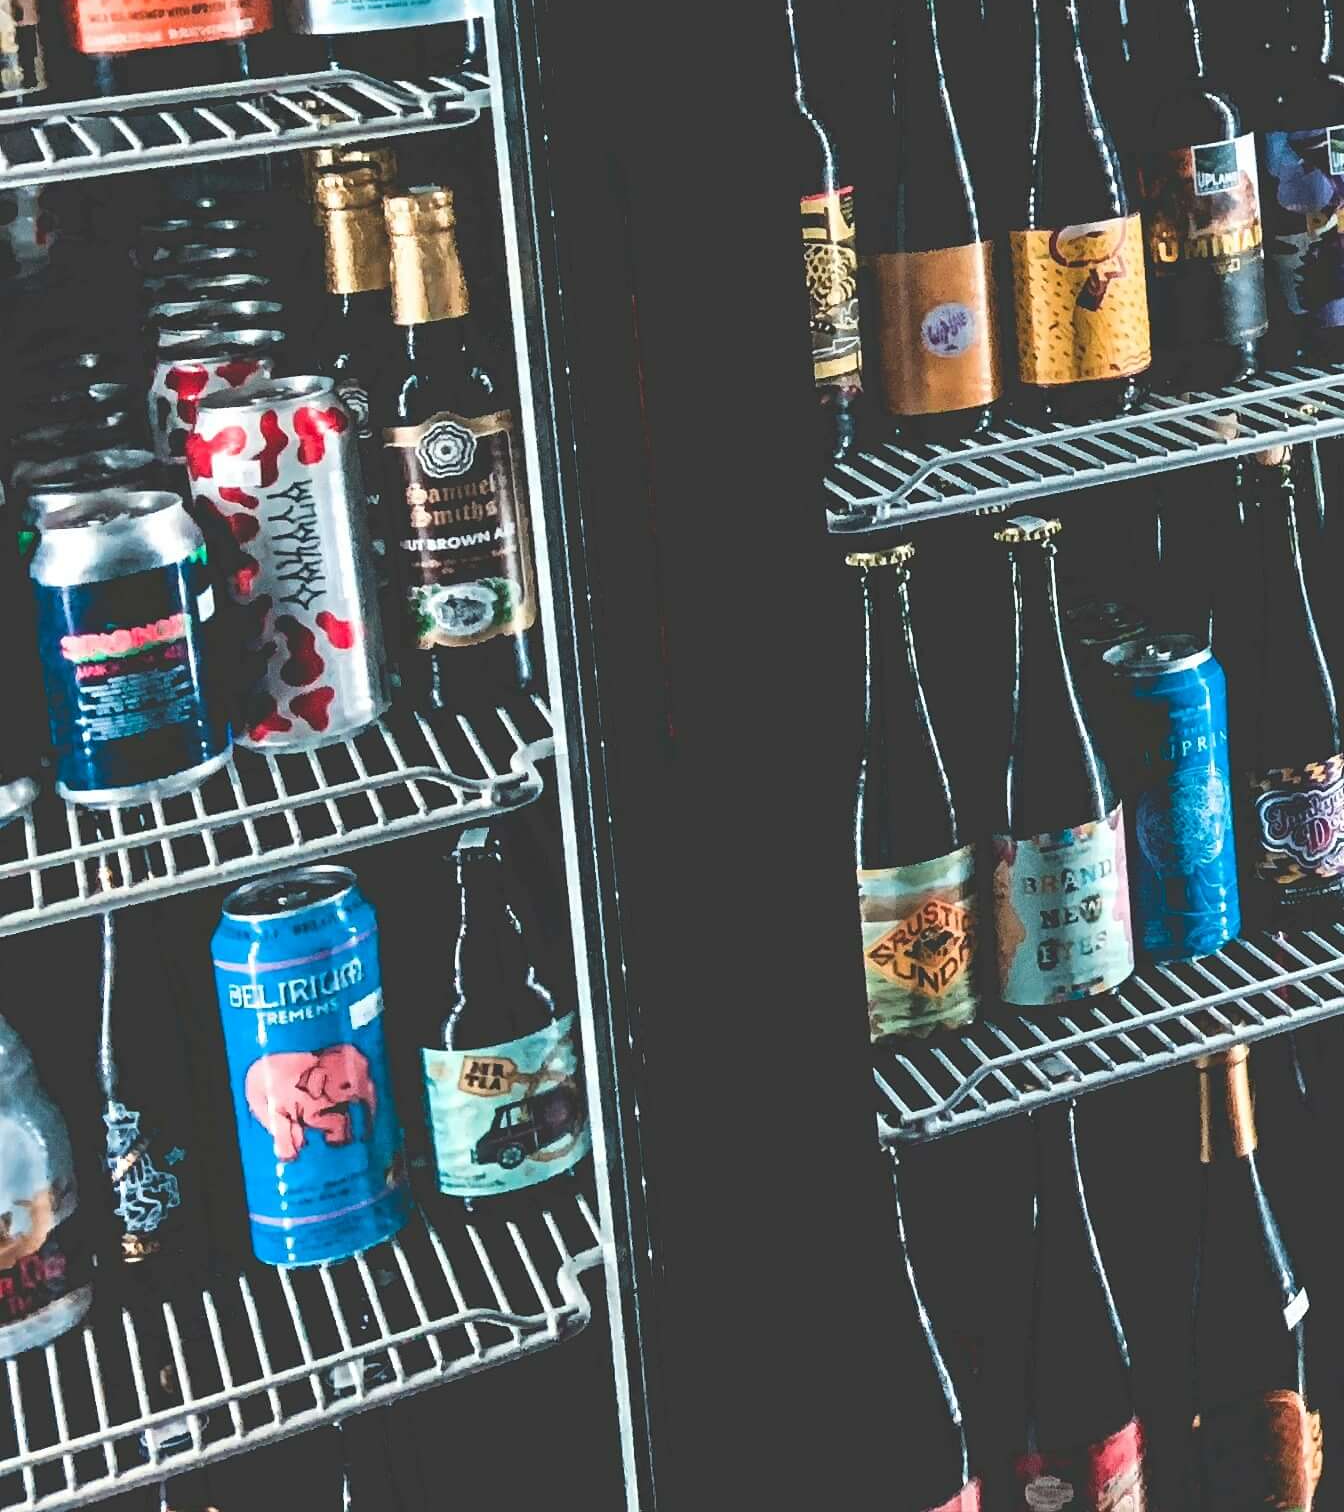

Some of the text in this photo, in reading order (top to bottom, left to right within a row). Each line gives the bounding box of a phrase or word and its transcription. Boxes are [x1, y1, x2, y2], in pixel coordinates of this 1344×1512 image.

[426, 530, 491, 552] BROWN
[1040, 893, 1105, 930] NEW
[228, 958, 362, 1009] DELIRIUM
[256, 997, 339, 1026] TREMENS
